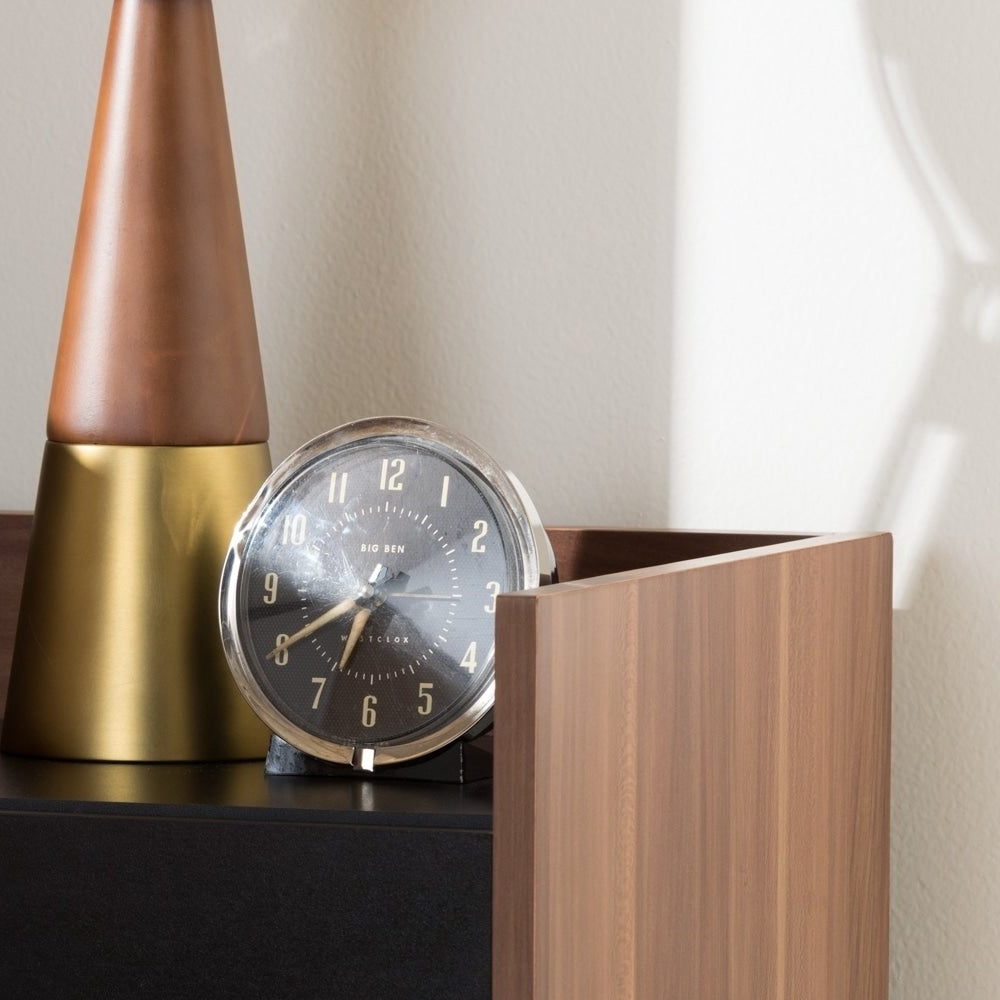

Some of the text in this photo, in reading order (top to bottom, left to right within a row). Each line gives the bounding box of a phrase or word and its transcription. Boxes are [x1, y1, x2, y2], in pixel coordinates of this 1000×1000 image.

[327, 472, 348, 503] 11
[379, 458, 406, 491] 12
[440, 475, 450, 507] 1
[281, 514, 307, 545] 10
[471, 519, 488, 553] 2
[360, 543, 405, 554] BIG BEN
[263, 572, 278, 604] 9
[483, 581, 500, 613] 3
[274, 633, 289, 666] 8
[340, 634, 409, 644] WSTCLOX
[460, 641, 478, 674] 4
[311, 677, 327, 709] 7
[417, 683, 434, 715] 5
[361, 695, 377, 728] 6
